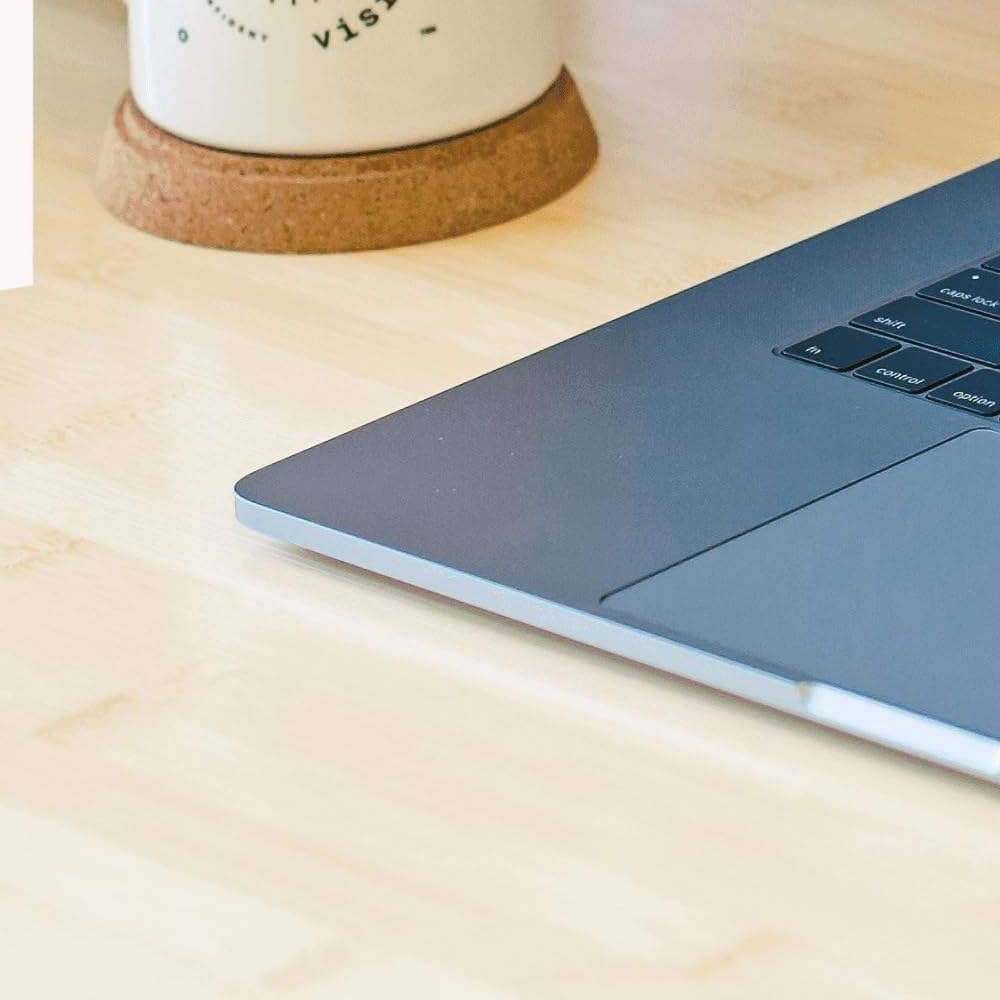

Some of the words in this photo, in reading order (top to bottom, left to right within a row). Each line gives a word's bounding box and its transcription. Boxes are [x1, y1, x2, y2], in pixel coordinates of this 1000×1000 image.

[940, 286, 971, 302] caps
[971, 294, 999, 309] lock
[873, 314, 907, 330] shift
[805, 345, 822, 356] fn
[875, 367, 925, 386] control
[952, 389, 996, 408] option
